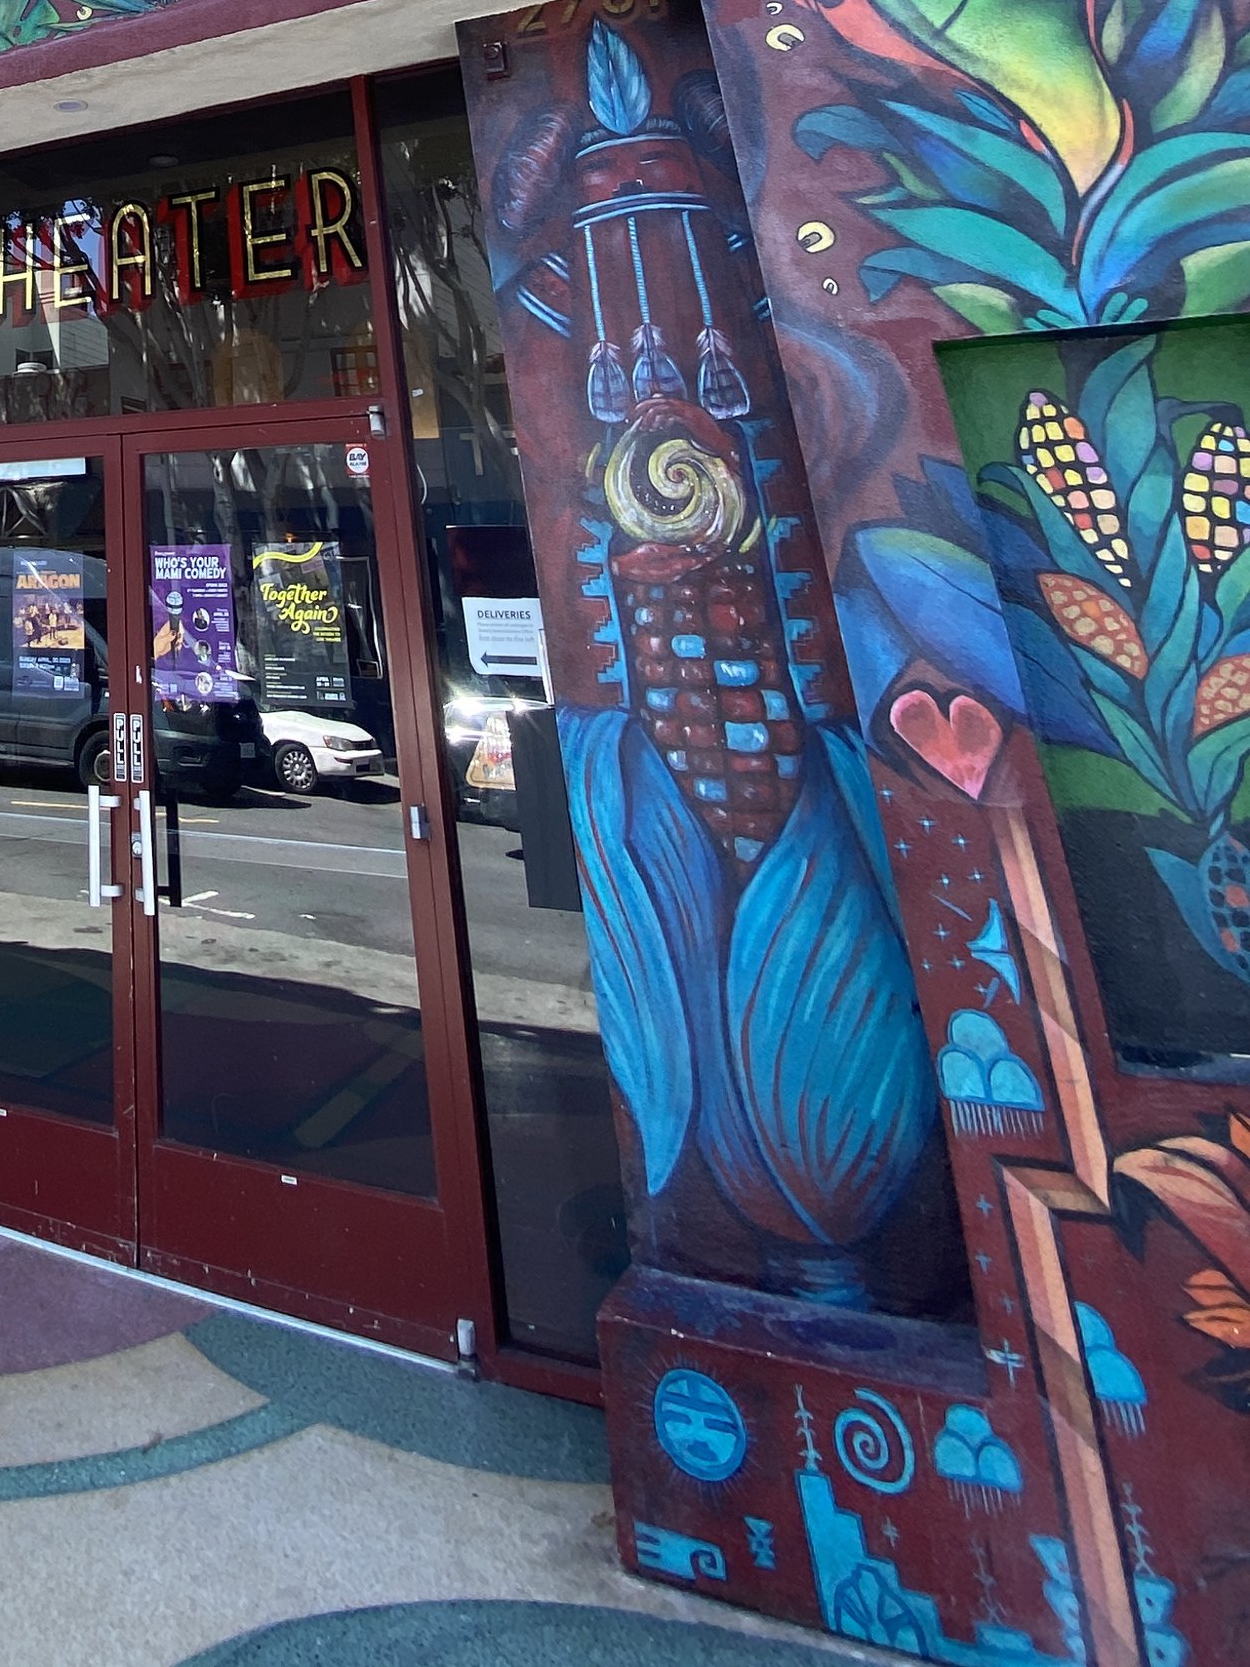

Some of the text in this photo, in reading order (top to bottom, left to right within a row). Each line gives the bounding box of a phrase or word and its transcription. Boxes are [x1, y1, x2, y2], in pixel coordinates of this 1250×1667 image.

[349, 453, 366, 461] BAY
[154, 556, 219, 569] WHO'S YOUR
[155, 567, 226, 580] MAMI COMEDY
[260, 583, 327, 608] Together
[278, 602, 338, 634] Again
[477, 609, 531, 620] DELIVERIES
[116, 718, 125, 765] PULL
[132, 720, 141, 766] PULL
